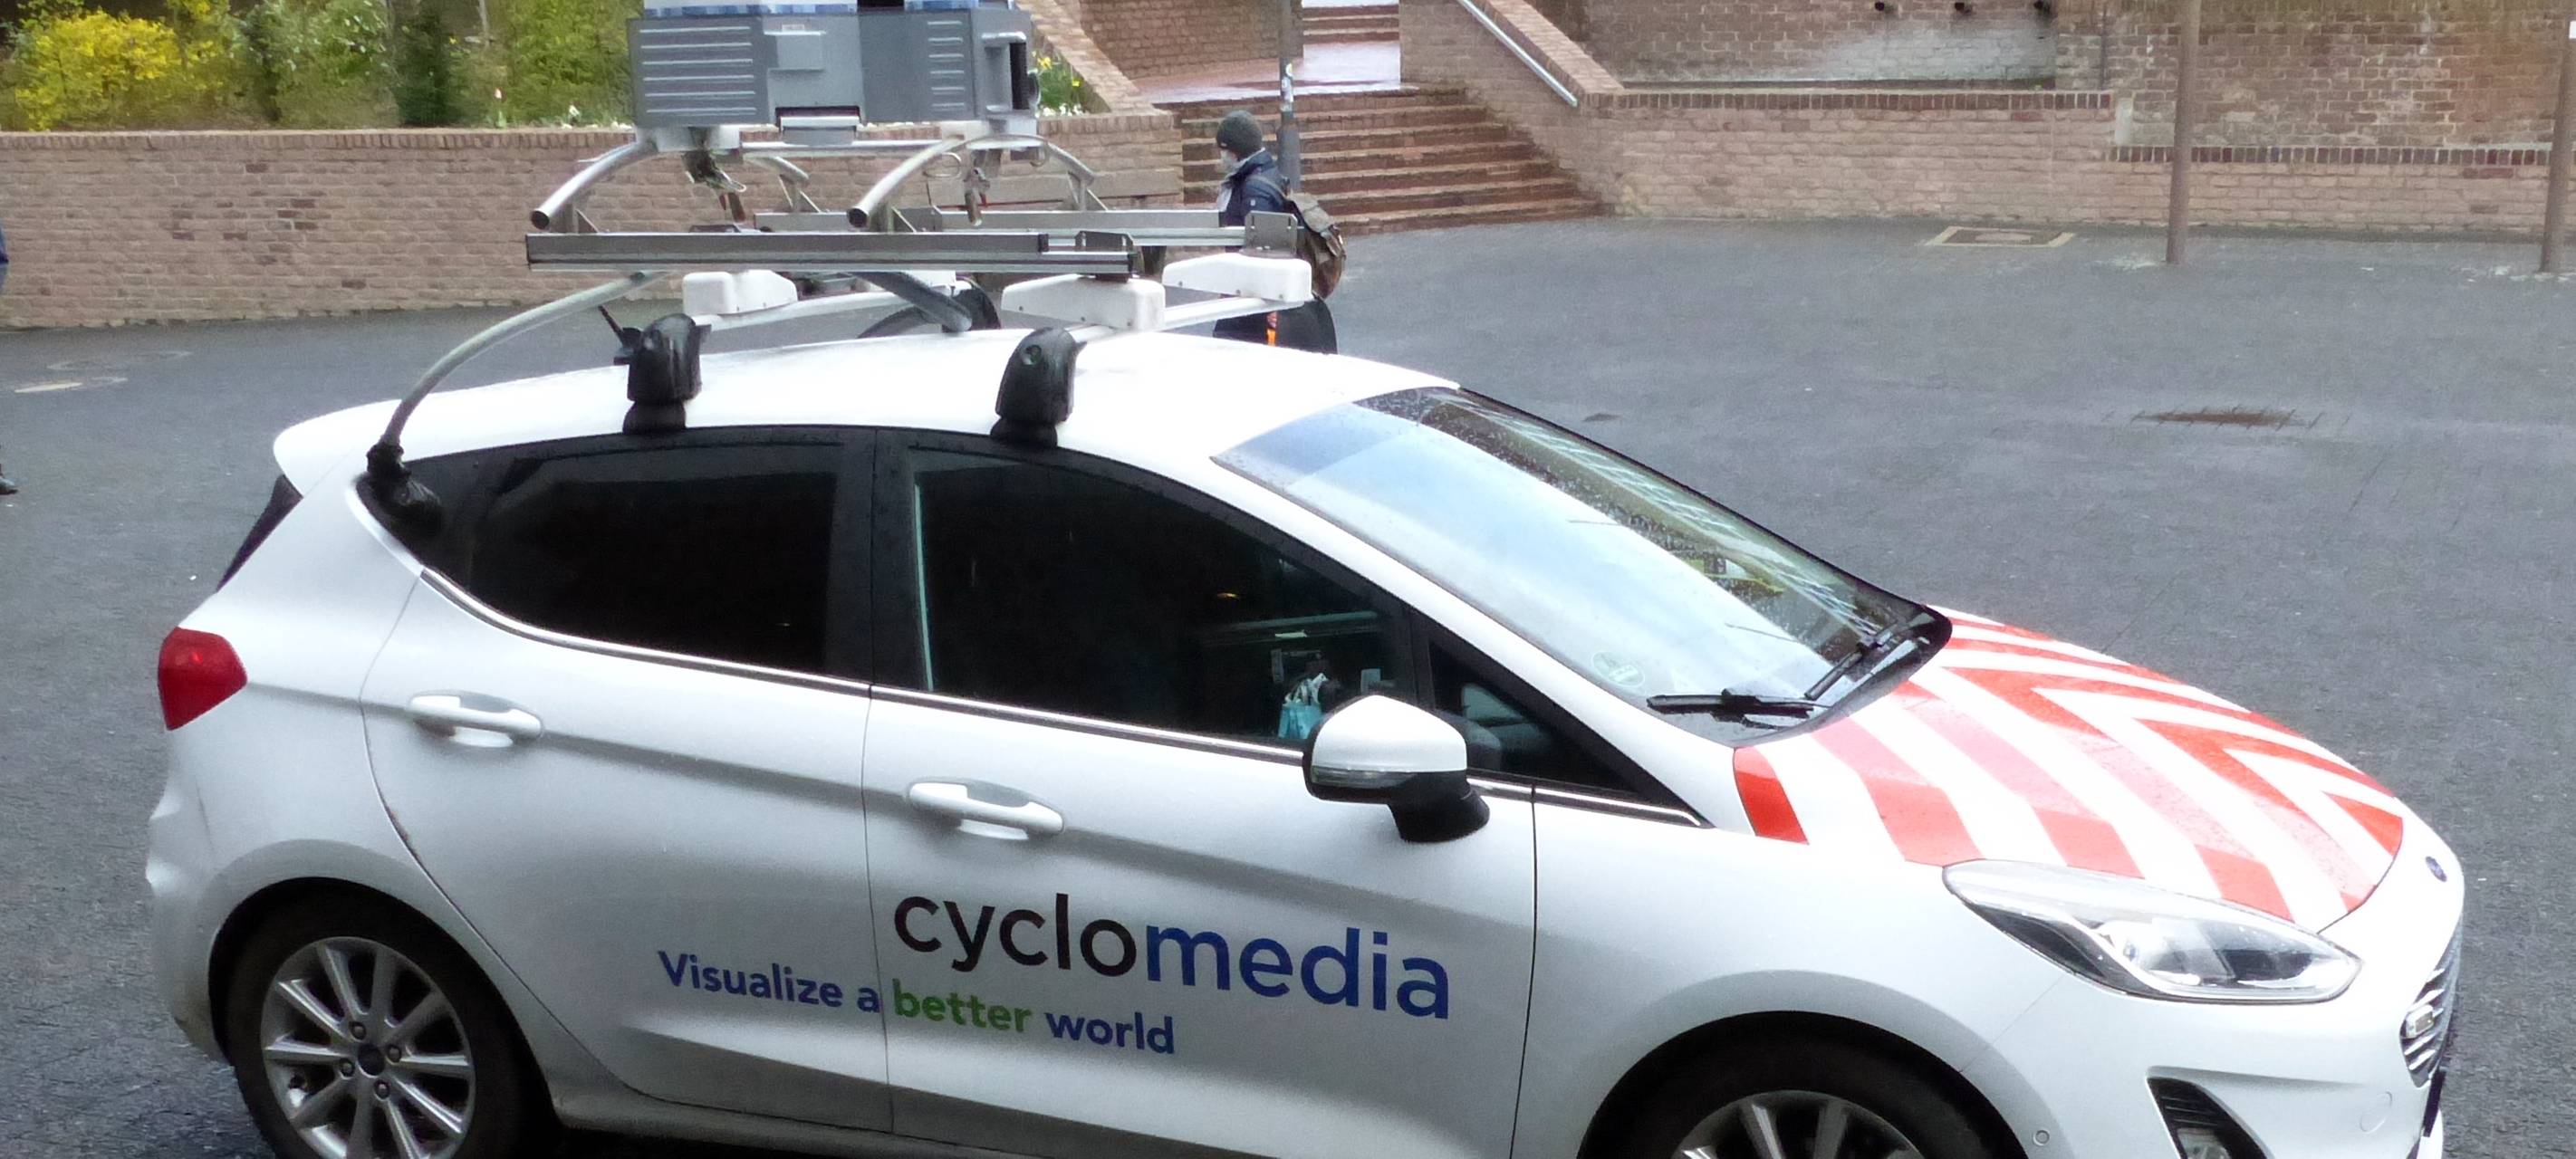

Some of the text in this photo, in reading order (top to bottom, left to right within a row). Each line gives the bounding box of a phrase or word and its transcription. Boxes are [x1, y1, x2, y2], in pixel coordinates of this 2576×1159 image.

[658, 951, 1175, 1055] Visualize a better world
[894, 893, 1449, 1020] cyclomedia
